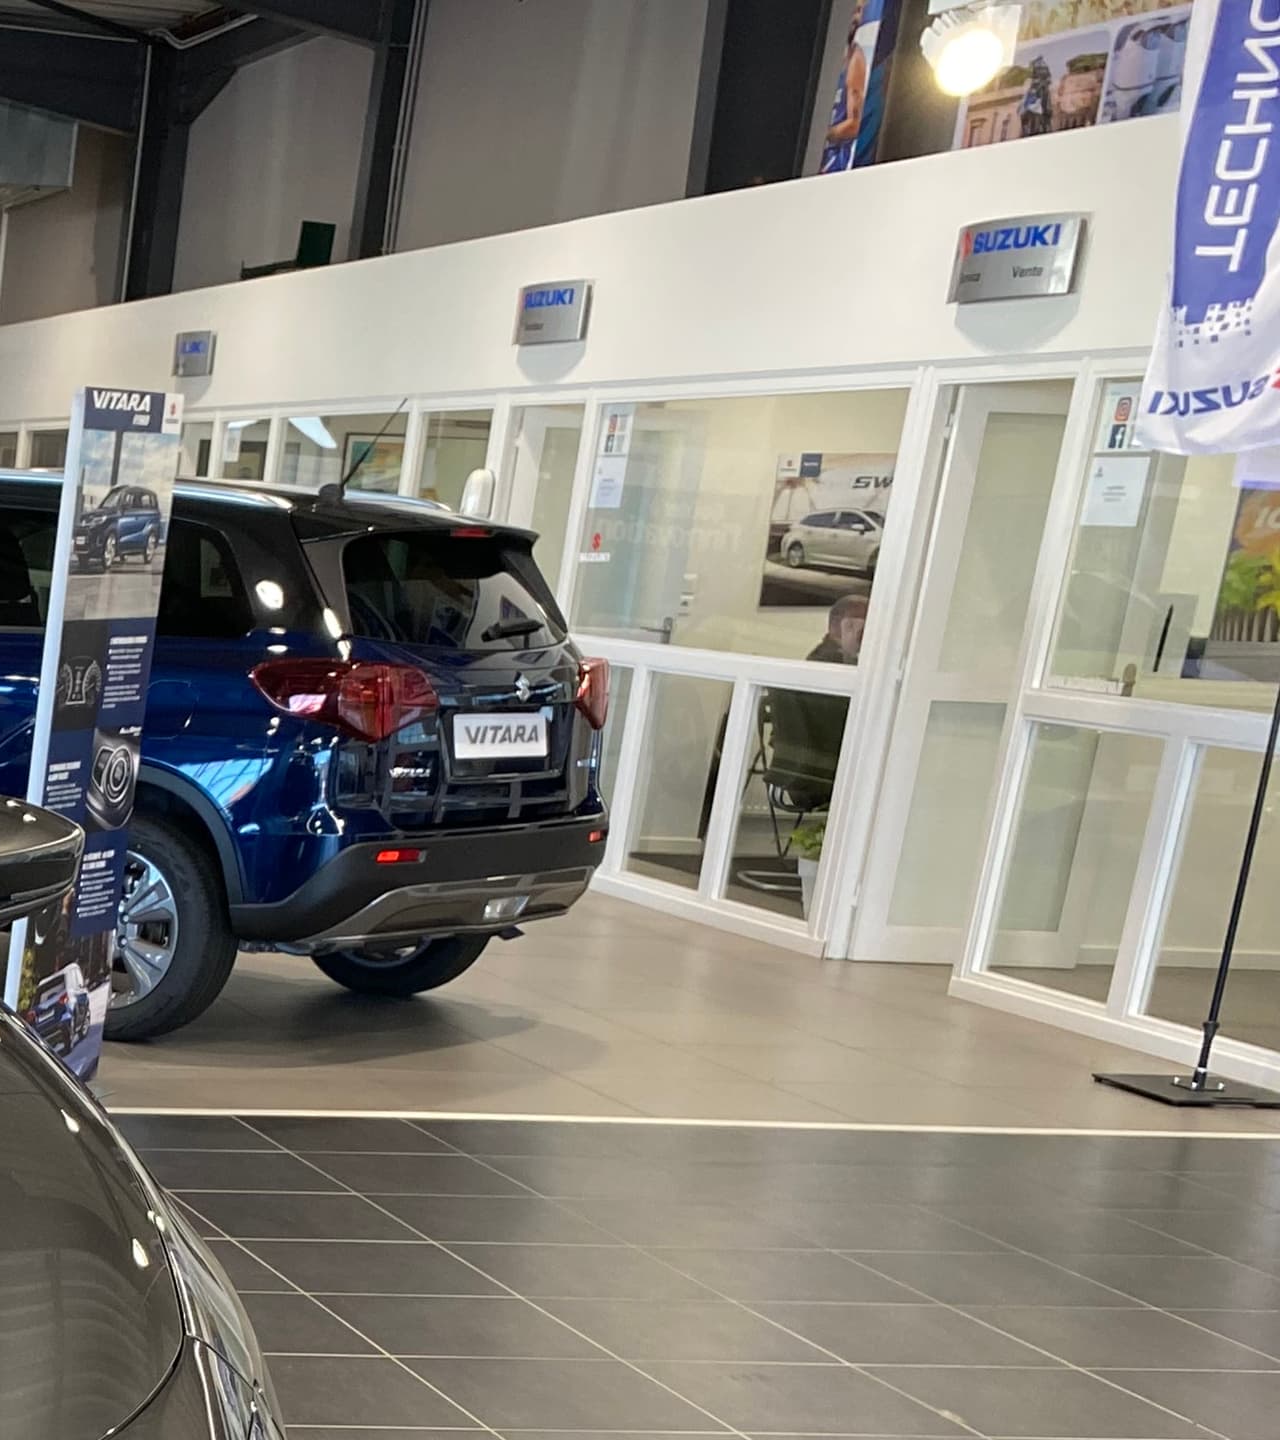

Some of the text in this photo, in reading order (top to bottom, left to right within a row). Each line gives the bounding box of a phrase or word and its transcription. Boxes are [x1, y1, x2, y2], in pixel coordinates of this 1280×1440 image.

[972, 223, 1062, 255] SUZUKI
[93, 390, 151, 412] VITARA
[465, 725, 540, 745] VITARA
